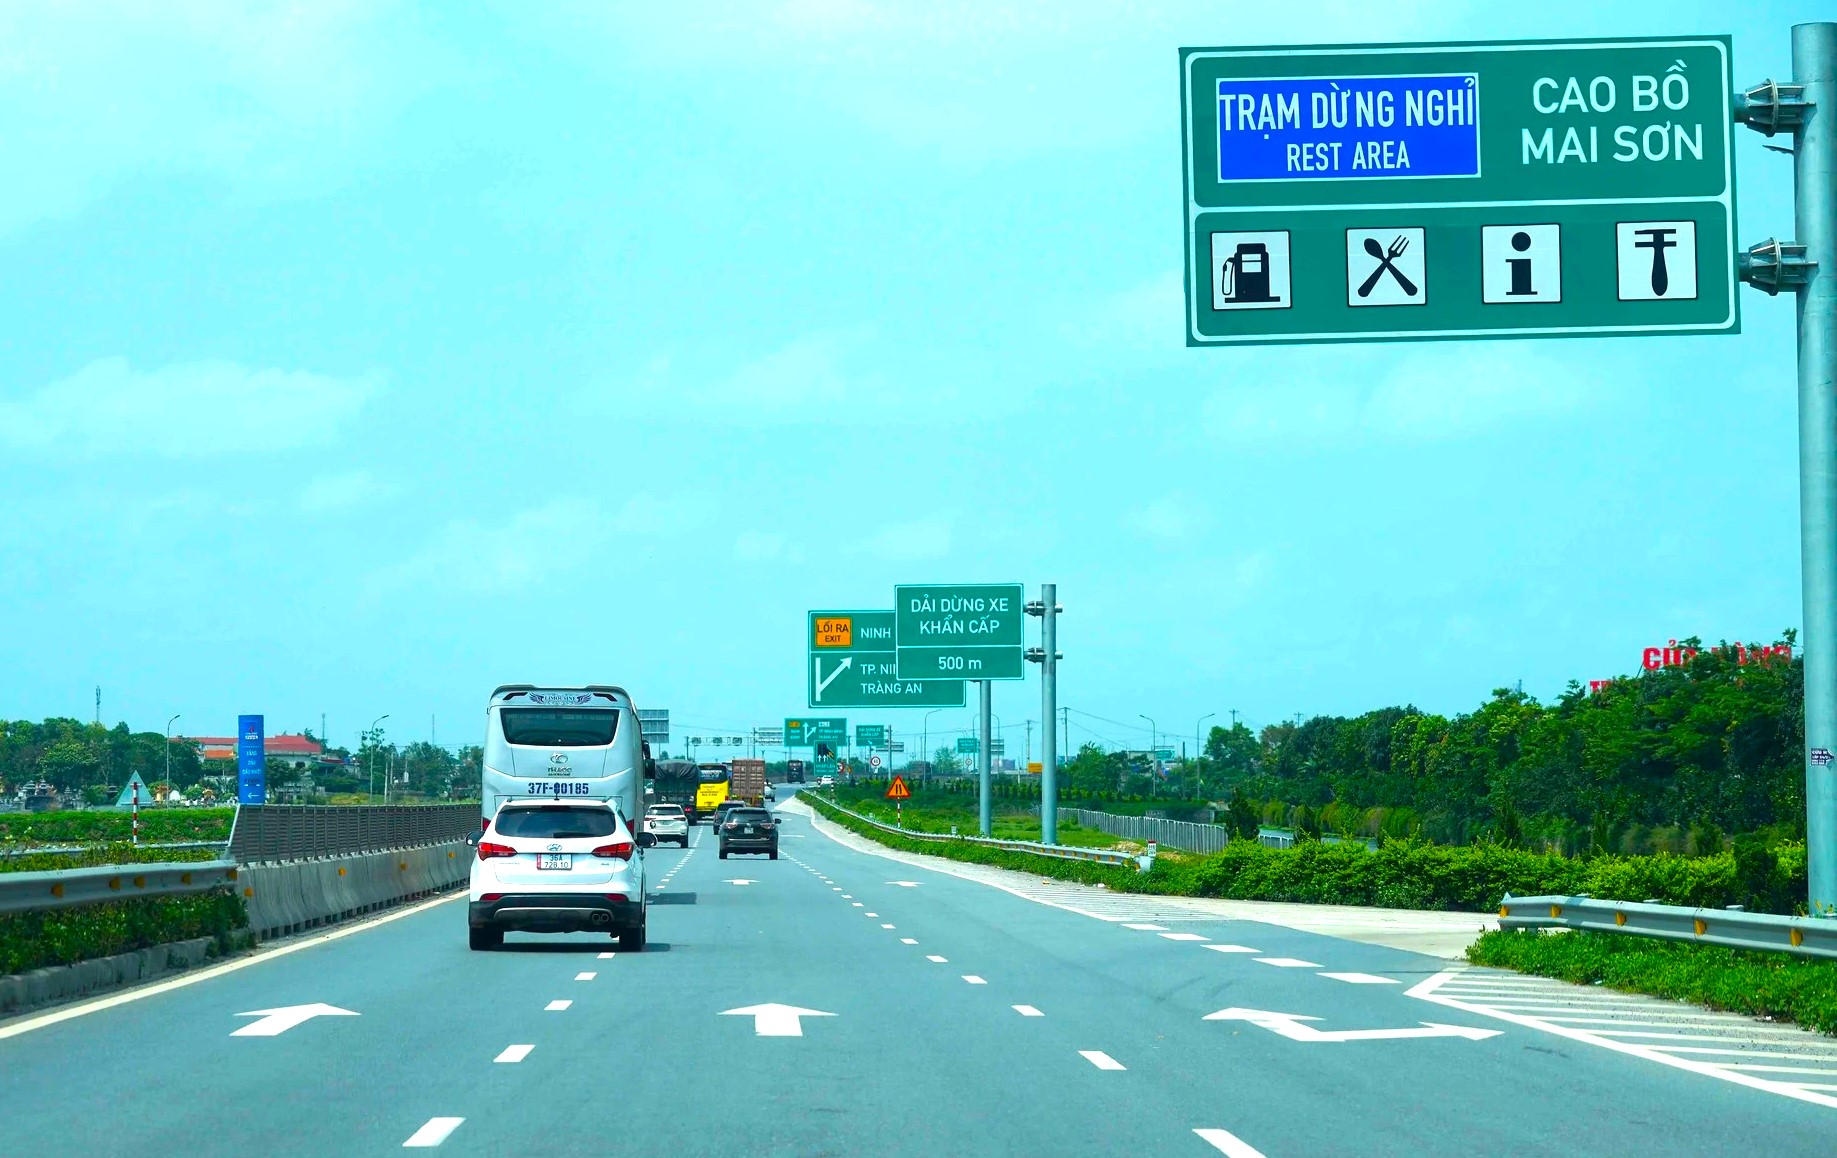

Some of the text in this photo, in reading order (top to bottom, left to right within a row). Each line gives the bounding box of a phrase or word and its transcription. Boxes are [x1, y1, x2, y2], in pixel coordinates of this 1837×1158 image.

[1532, 59, 1690, 114] CAO BỒ
[1219, 77, 1476, 139] TRẠM DỪNG NGHỈ
[1521, 120, 1704, 165] MAI SƠN
[1286, 140, 1411, 172] REST AREA
[911, 594, 1009, 613] DẢI DỪNG XE
[817, 621, 849, 633] LỐI RA
[919, 614, 1001, 635] KHẨN CẤP
[824, 635, 842, 643] EXIT
[860, 627, 891, 639] NINH
[860, 663, 877, 675] TP.
[938, 656, 982, 670] 500 m
[860, 680, 923, 694] TRÀNG AN
[528, 782, 590, 794] 37F-00185
